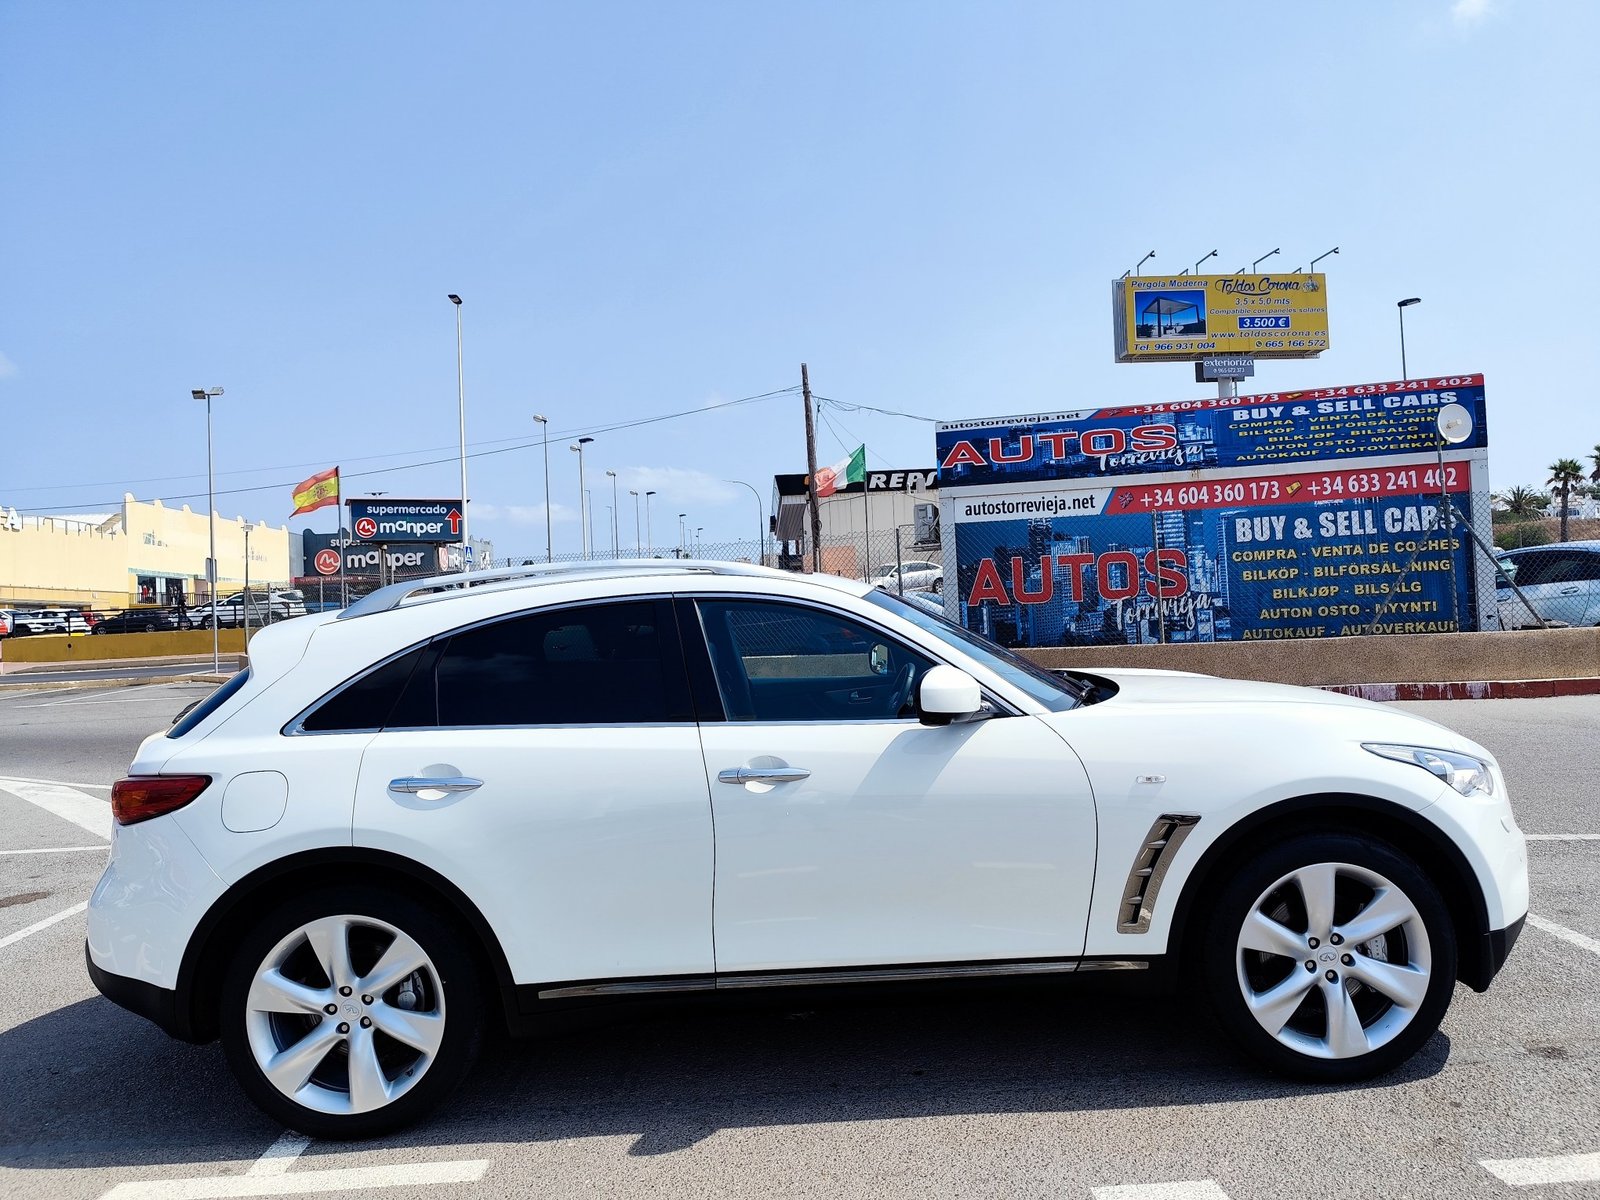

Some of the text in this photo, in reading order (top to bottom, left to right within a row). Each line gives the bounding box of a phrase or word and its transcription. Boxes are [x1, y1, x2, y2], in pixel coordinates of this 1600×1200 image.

[1168, 279, 1208, 288] Moderna
[1214, 277, 1300, 294] Toldos Corona
[1235, 298, 1248, 306] 3,5
[1258, 297, 1272, 305] 5,0
[1243, 317, 1287, 328] 3.500 €
[1134, 343, 1151, 351] Tel.
[1154, 342, 1173, 351] 966
[1175, 342, 1194, 350] 931
[1196, 341, 1216, 350] 004
[1265, 340, 1284, 348] 665
[1307, 339, 1326, 347] 572
[1204, 358, 1253, 367] exterioriza
[1129, 377, 1473, 414] +34 604 360 173 +34 633 241 402
[1233, 391, 1458, 421] BUY & SELL CARS
[941, 412, 1081, 431] autostorrevieja.net
[1228, 419, 1294, 429] COMPRA
[1308, 413, 1361, 423] VENTA
[1392, 407, 1442, 416] COCH
[1238, 426, 1295, 437] BILKÖP
[1310, 416, 1436, 431] BILFÖRSÄLJNIN
[1254, 442, 1308, 452] AUTON
[1313, 438, 1356, 447] OSTO
[1371, 433, 1434, 443] MYYNTI
[1268, 432, 1335, 443] BILKJØP
[1350, 426, 1419, 436] BILSALG
[941, 424, 1178, 469] AUTOS
[1236, 449, 1320, 461] AUTOKAUF
[1096, 445, 1202, 471] Torrevieja
[1140, 488, 1174, 508] +34
[1178, 486, 1209, 505] 604
[1213, 483, 1245, 503] 360
[1249, 480, 1281, 500] 173
[1307, 476, 1344, 496] +34
[1347, 473, 1381, 493] 633
[1386, 470, 1417, 490] 241
[366, 504, 447, 515] supermercado
[965, 494, 1096, 516] autostorrevieja.net
[379, 520, 444, 537] manper
[1235, 515, 1287, 543] BUY
[1293, 517, 1313, 539] &
[1318, 509, 1378, 538] SELL
[1232, 548, 1298, 562] COMPRA
[1311, 544, 1364, 558] VENTA
[1368, 543, 1389, 554] DE
[968, 548, 1188, 607] AUTOS
[1242, 566, 1299, 581] BILKÖP
[1313, 559, 1451, 578] BILFÖRSÄLNING
[1272, 585, 1339, 599] BILKJØP
[1259, 607, 1313, 620] AUTON
[1317, 604, 1360, 617] OSTO
[1242, 626, 1326, 640] AUTOKAUF
